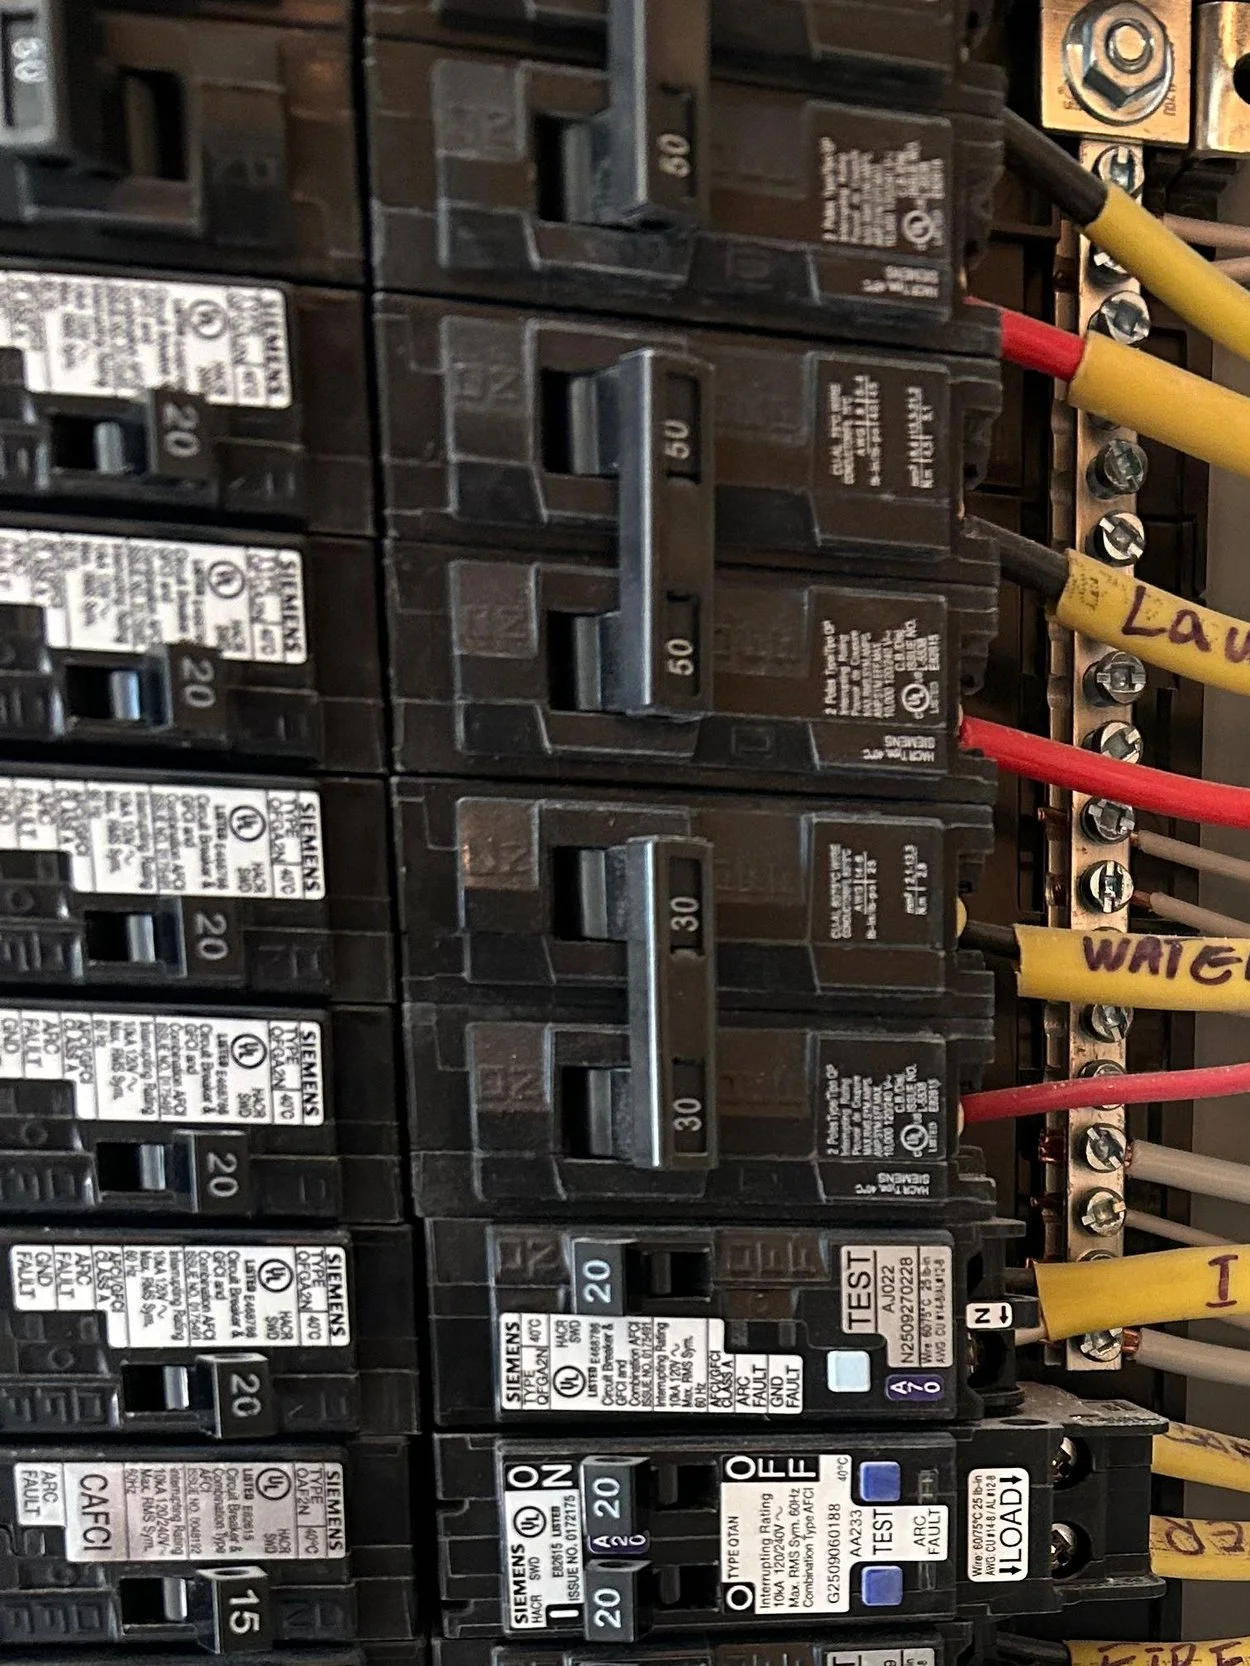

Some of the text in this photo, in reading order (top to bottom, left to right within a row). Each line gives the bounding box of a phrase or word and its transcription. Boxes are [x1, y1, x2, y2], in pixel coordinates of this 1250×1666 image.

[162, 403, 198, 458] 20
[664, 419, 690, 460] 50
[668, 637, 695, 676] 50
[181, 658, 216, 709] 20
[301, 802, 320, 892] SIEMENS
[196, 913, 228, 960] 20
[670, 897, 699, 933] 30
[300, 1031, 319, 1117] SIEMENS
[674, 1098, 701, 1132] 30
[207, 1152, 238, 1198] 20
[327, 1254, 346, 1336] SIEMENS
[583, 1259, 611, 1303] 20
[847, 1251, 871, 1330] TEST
[882, 1265, 895, 1314] AJ022
[900, 1257, 914, 1364] N2509270228
[975, 1308, 990, 1324] N
[506, 1321, 520, 1402] SIEMENS
[230, 1373, 261, 1417] 20
[524, 1370, 536, 1405] TYPE
[737, 1376, 751, 1408] ARC
[753, 1365, 767, 1409] FAULT
[770, 1376, 784, 1407] GND
[786, 1365, 800, 1409] FAULT
[39, 1469, 59, 1504] ARC
[507, 1464, 573, 1487] ON
[725, 1456, 816, 1480] OFF
[20, 1470, 40, 1517] FAULT
[79, 1474, 112, 1552] CAFCI
[326, 1471, 344, 1552] SIEMENS
[593, 1477, 621, 1519] 20
[551, 1506, 564, 1578] E82615 LISTED
[563, 1494, 580, 1601] ISSUE NO. 0172175
[728, 1515, 740, 1579] TYPE QTAN
[789, 1488, 804, 1608] Max. RMS Sym. 60Hz
[803, 1487, 817, 1608] Combination Type AFCI
[850, 1509, 863, 1558] AA233
[872, 1509, 893, 1556] TEST
[914, 1514, 926, 1546] ARC
[927, 1509, 940, 1554] FAULT
[1000, 1488, 1022, 1562] LOAD
[760, 1493, 774, 1609] Interrupting Rating
[827, 1503, 841, 1605] G2509060188
[511, 1543, 529, 1624] SIEMENS
[530, 1557, 544, 1623] HACR SWD
[229, 1587, 260, 1635] 15
[593, 1588, 621, 1628] 20
